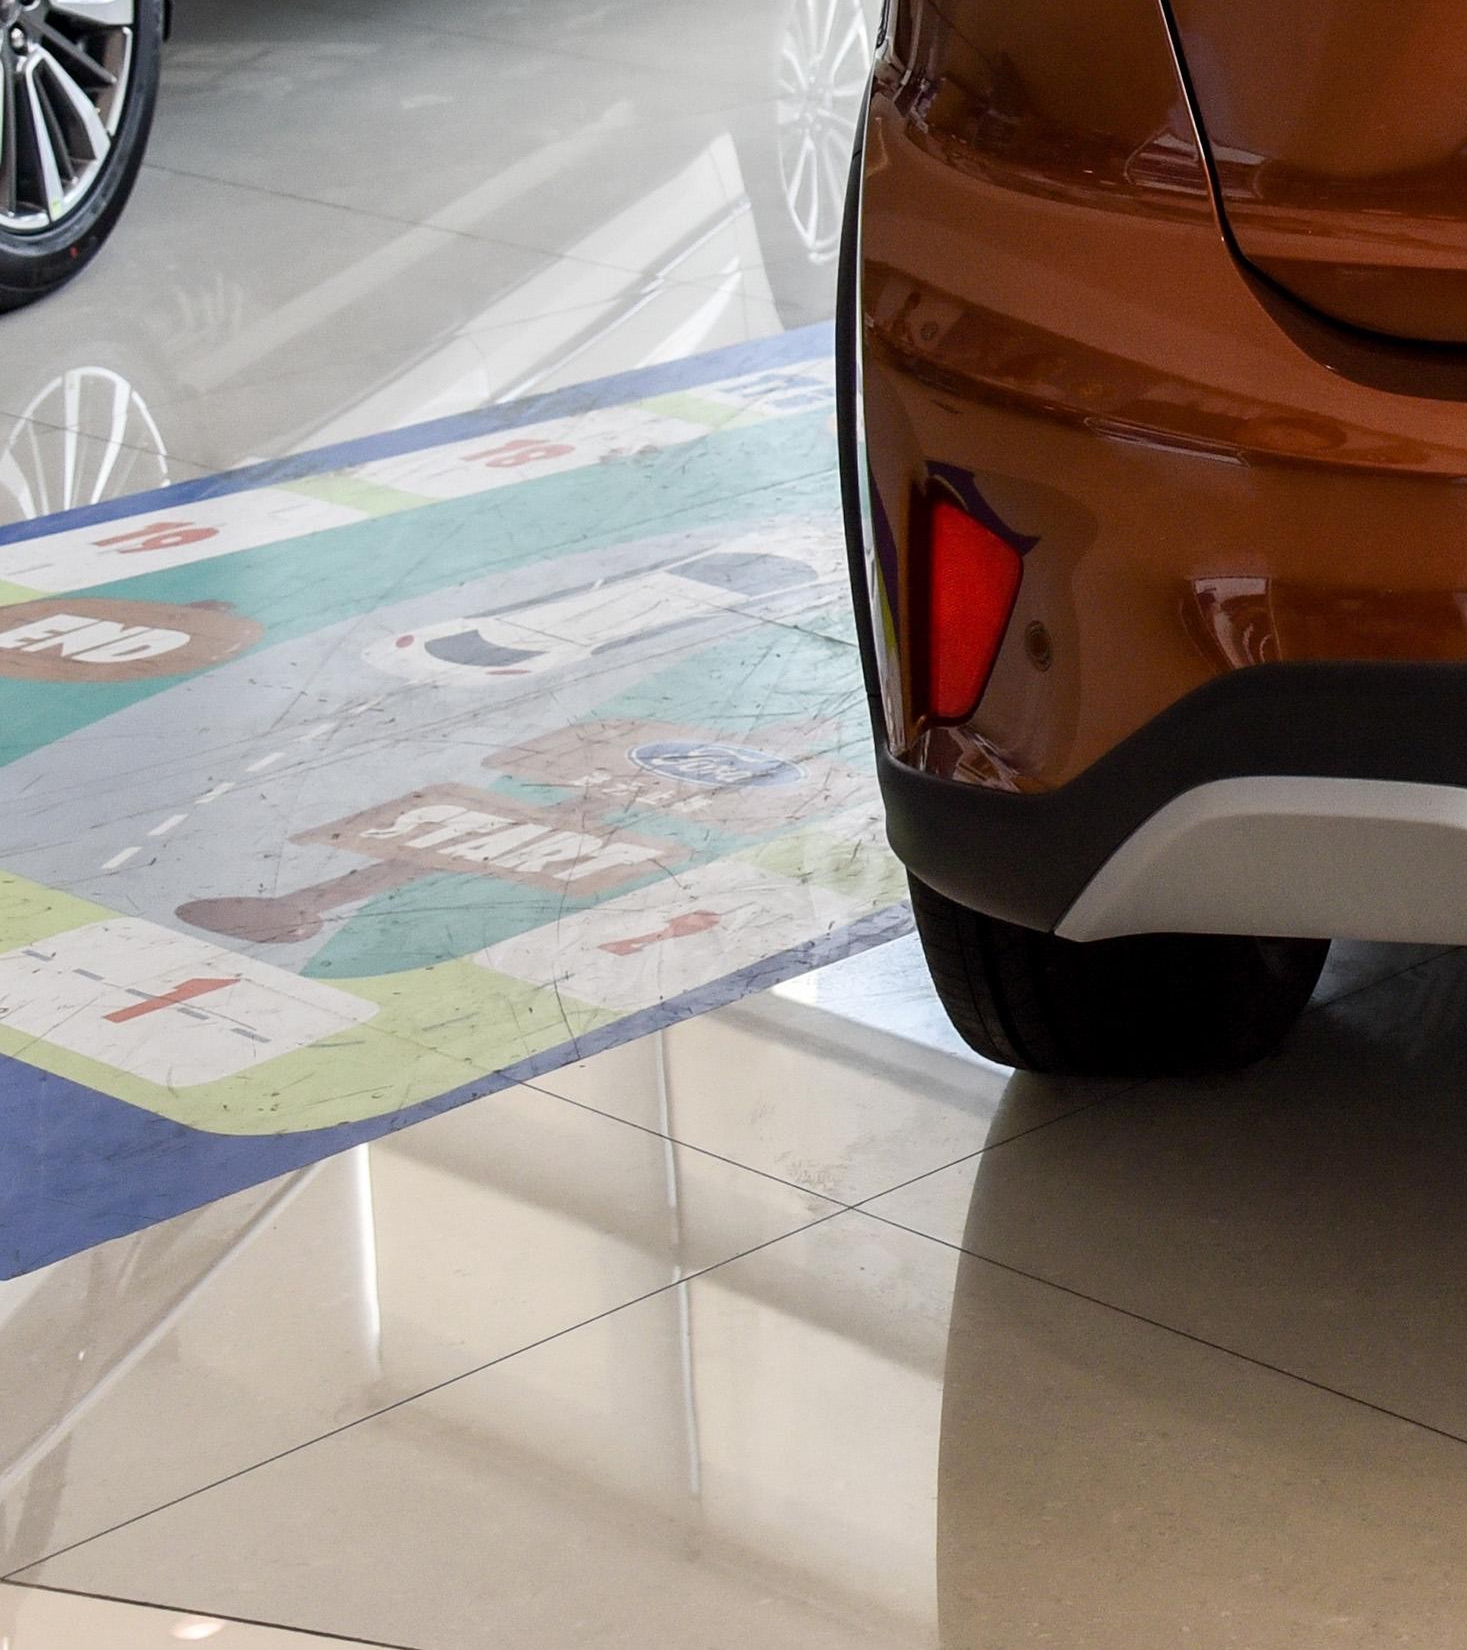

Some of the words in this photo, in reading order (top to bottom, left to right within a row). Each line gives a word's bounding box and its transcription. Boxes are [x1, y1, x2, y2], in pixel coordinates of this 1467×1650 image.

[91, 521, 220, 554] 19
[0, 613, 191, 664] END
[359, 804, 663, 882] START
